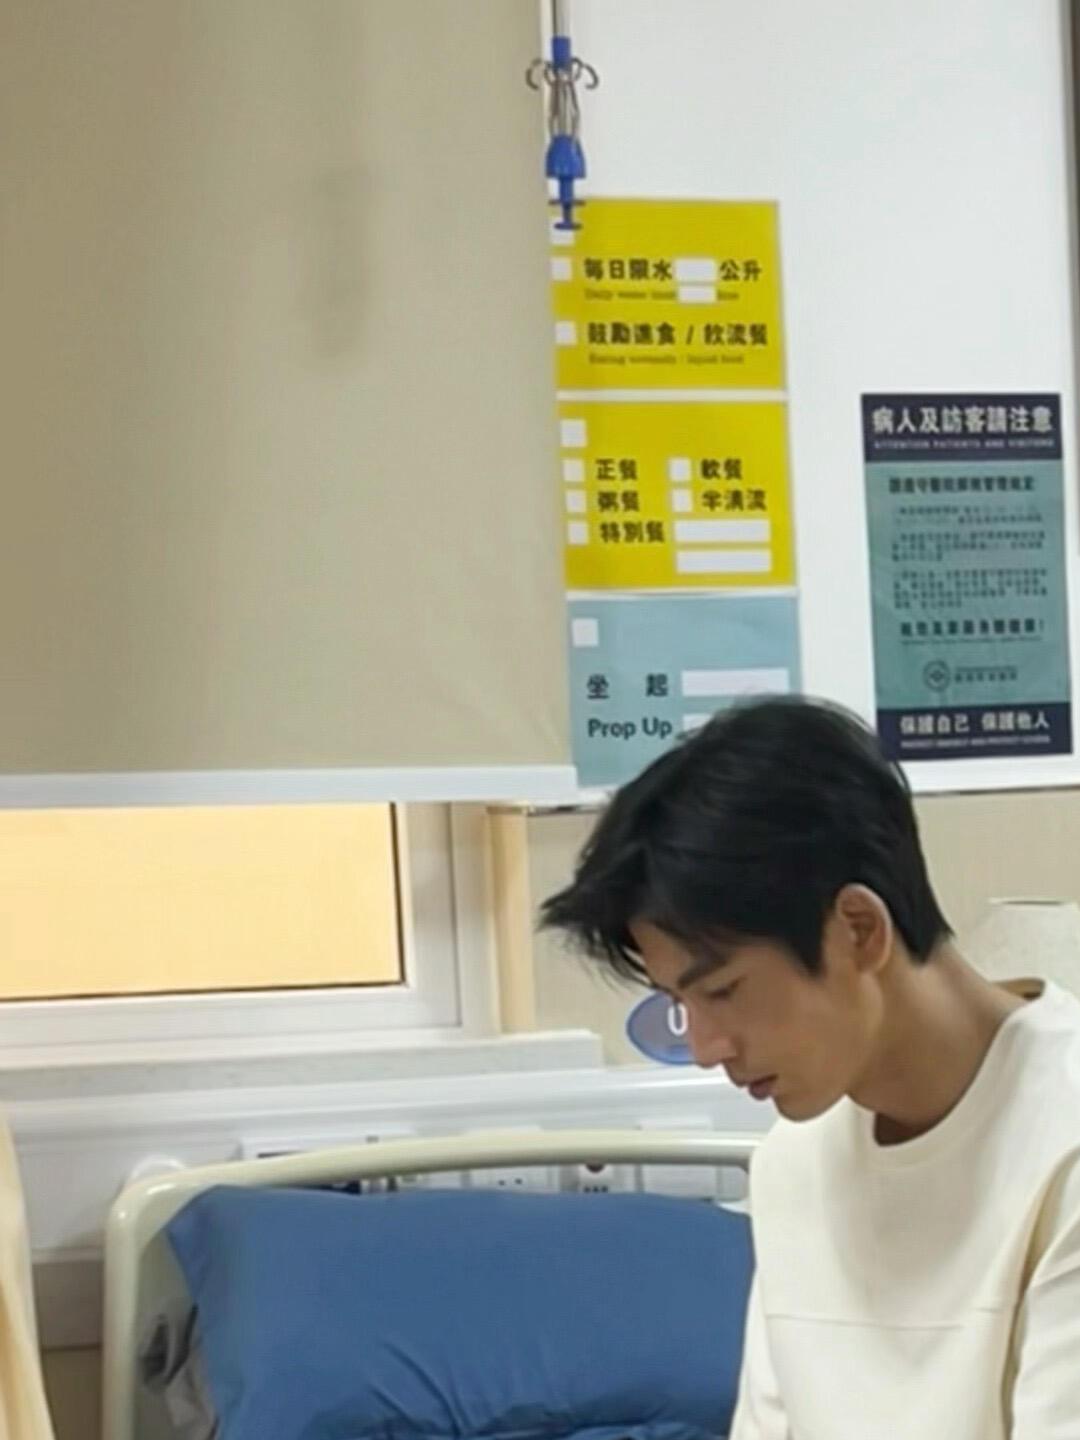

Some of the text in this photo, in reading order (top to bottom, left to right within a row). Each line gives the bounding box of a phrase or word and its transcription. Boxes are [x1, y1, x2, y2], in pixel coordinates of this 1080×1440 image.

[719, 259, 762, 281] 公升
[872, 405, 1052, 434] 病人及訪客請注意
[595, 458, 637, 480] 正餐
[701, 458, 742, 480] 軟餐
[597, 490, 640, 512] 粥餐
[600, 521, 665, 543] 特別餐
[587, 717, 673, 740] Prop Up
[901, 711, 1050, 735] 保護自己 保護他人
